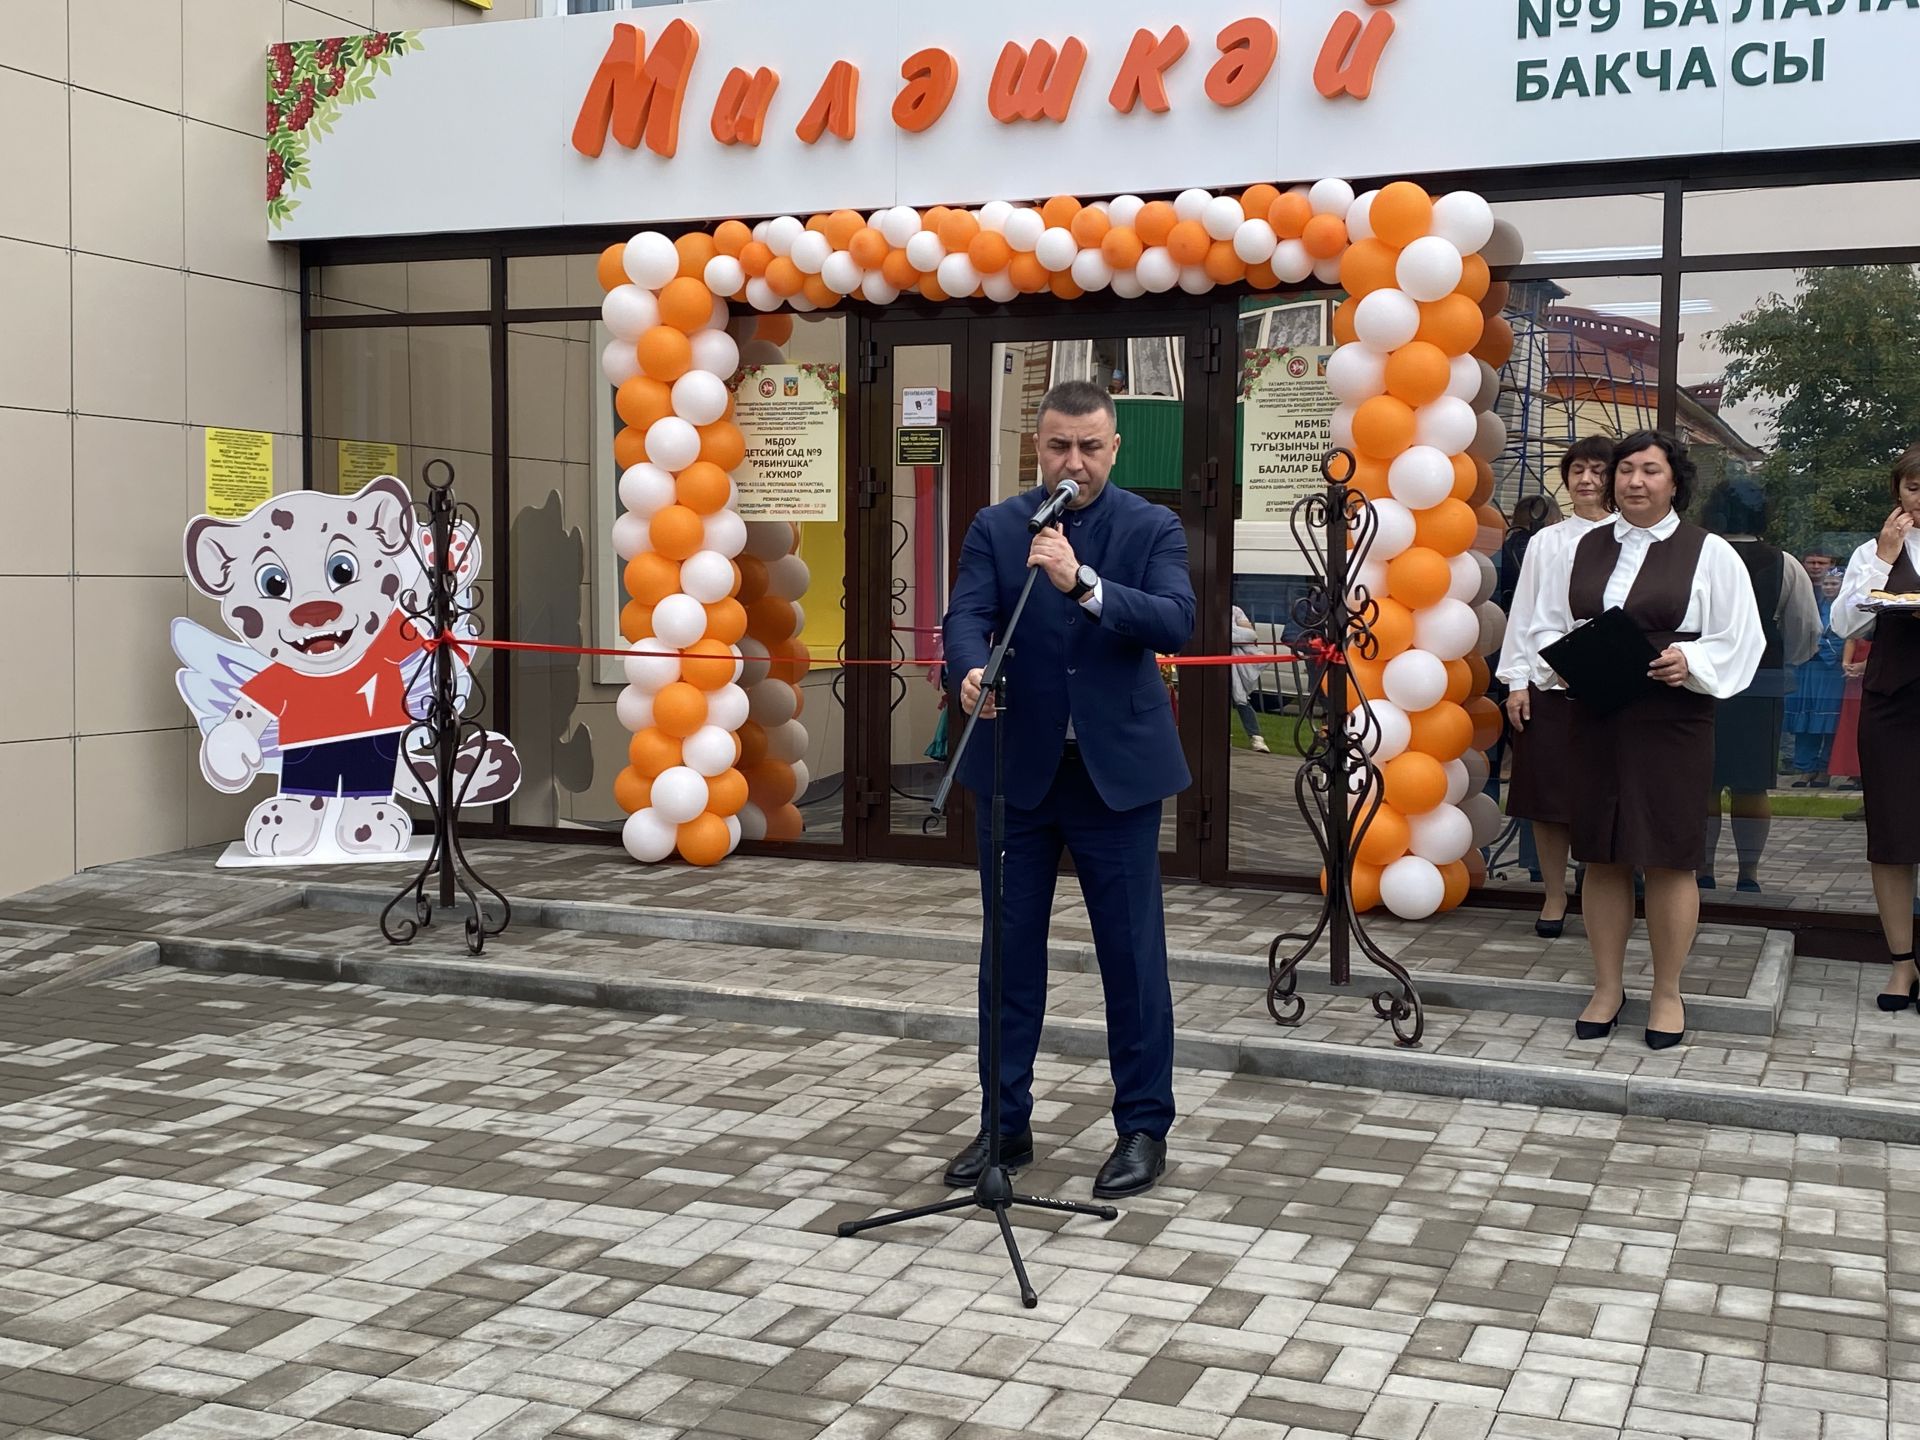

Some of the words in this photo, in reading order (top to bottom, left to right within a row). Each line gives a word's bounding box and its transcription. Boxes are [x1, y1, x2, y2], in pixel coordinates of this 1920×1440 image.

[765, 438, 796, 447] МБДОУ
[1250, 442, 1319, 452] ТУГЫЗЫНЧЫ
[744, 446, 784, 458] ДЕТСКИЙ
[787, 449, 804, 458] САД
[749, 460, 813, 468] "РЯБИНУШКА"
[1259, 465, 1309, 474] БАЛАЛАР
[759, 471, 803, 479] г.КУКМОР
